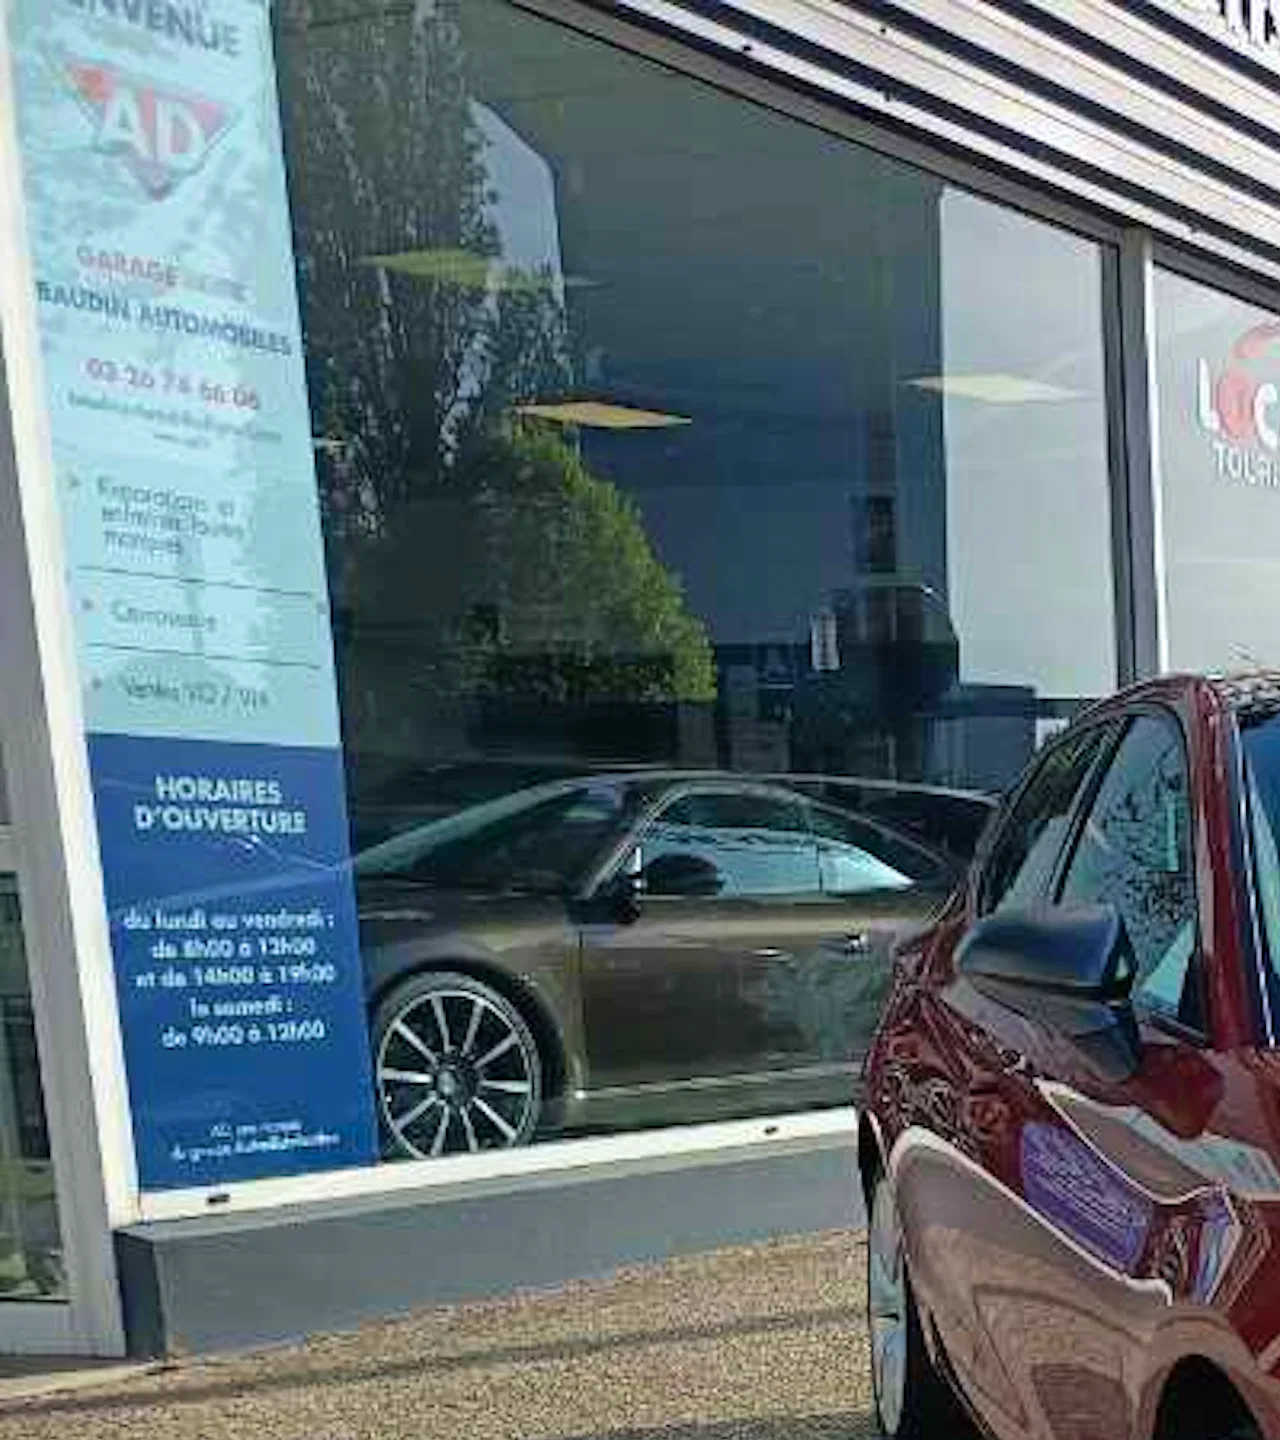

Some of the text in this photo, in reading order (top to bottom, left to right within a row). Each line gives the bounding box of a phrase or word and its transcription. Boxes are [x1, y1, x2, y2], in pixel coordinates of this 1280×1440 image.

[138, 304, 293, 355] AUTOMOBILES
[155, 774, 283, 805] HORAIRES
[134, 804, 307, 836] D'OUVERTURE
[123, 907, 150, 930] du
[154, 908, 207, 930] lundi
[210, 915, 238, 930] au
[241, 906, 325, 930] vendredi
[151, 938, 179, 960] de
[258, 936, 316, 958] 12h00
[160, 967, 188, 988] de
[194, 965, 255, 986] 14h00
[212, 994, 284, 1017] samedi
[161, 1026, 188, 1048] de
[267, 1020, 326, 1042] 12h00
